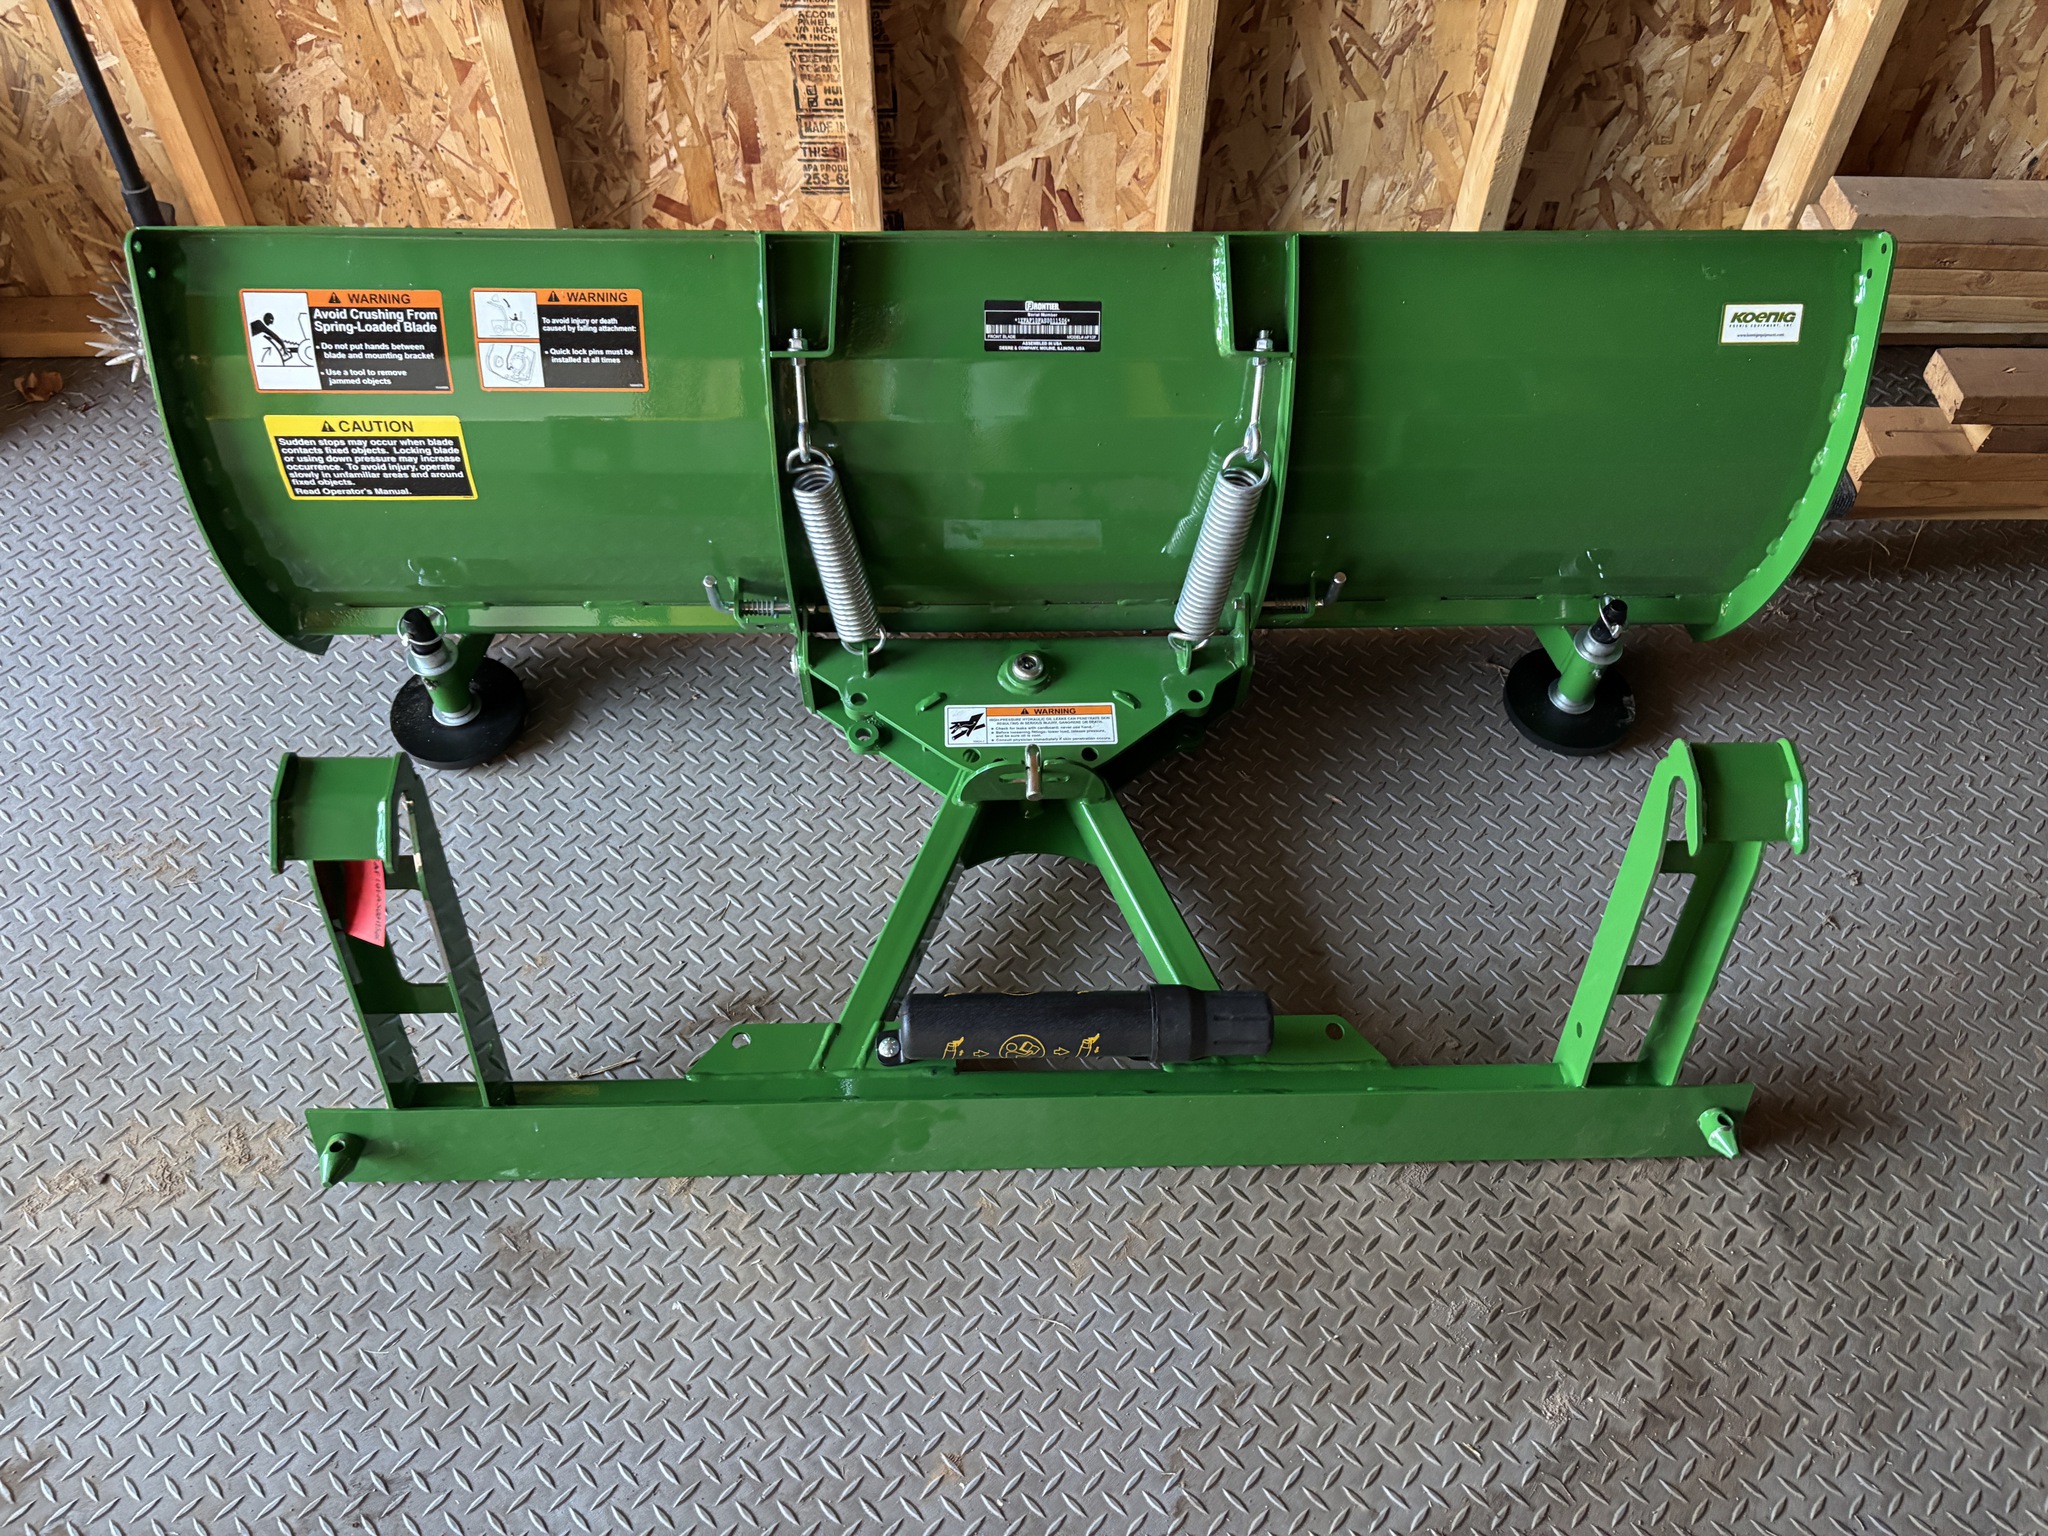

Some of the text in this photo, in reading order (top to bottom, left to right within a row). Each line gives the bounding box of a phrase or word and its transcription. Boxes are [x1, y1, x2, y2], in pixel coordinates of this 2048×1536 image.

[804, 121, 832, 133] MADE
[800, 146, 829, 158] THIS
[803, 164, 818, 172] APA
[348, 294, 410, 304] WARNING
[567, 292, 628, 302] WARNING
[1024, 301, 1060, 311] FRONTIER
[314, 309, 438, 322] Avoid Crushing From
[570, 318, 589, 326] injury
[314, 321, 437, 334] Spring-Loaded Blade
[350, 344, 364, 352] put
[365, 352, 403, 361] mounting
[338, 421, 414, 432] CAUTION
[318, 439, 345, 447] stops
[351, 447, 389, 455] objects.
[394, 447, 431, 455] Locking
[389, 464, 418, 472] injury,
